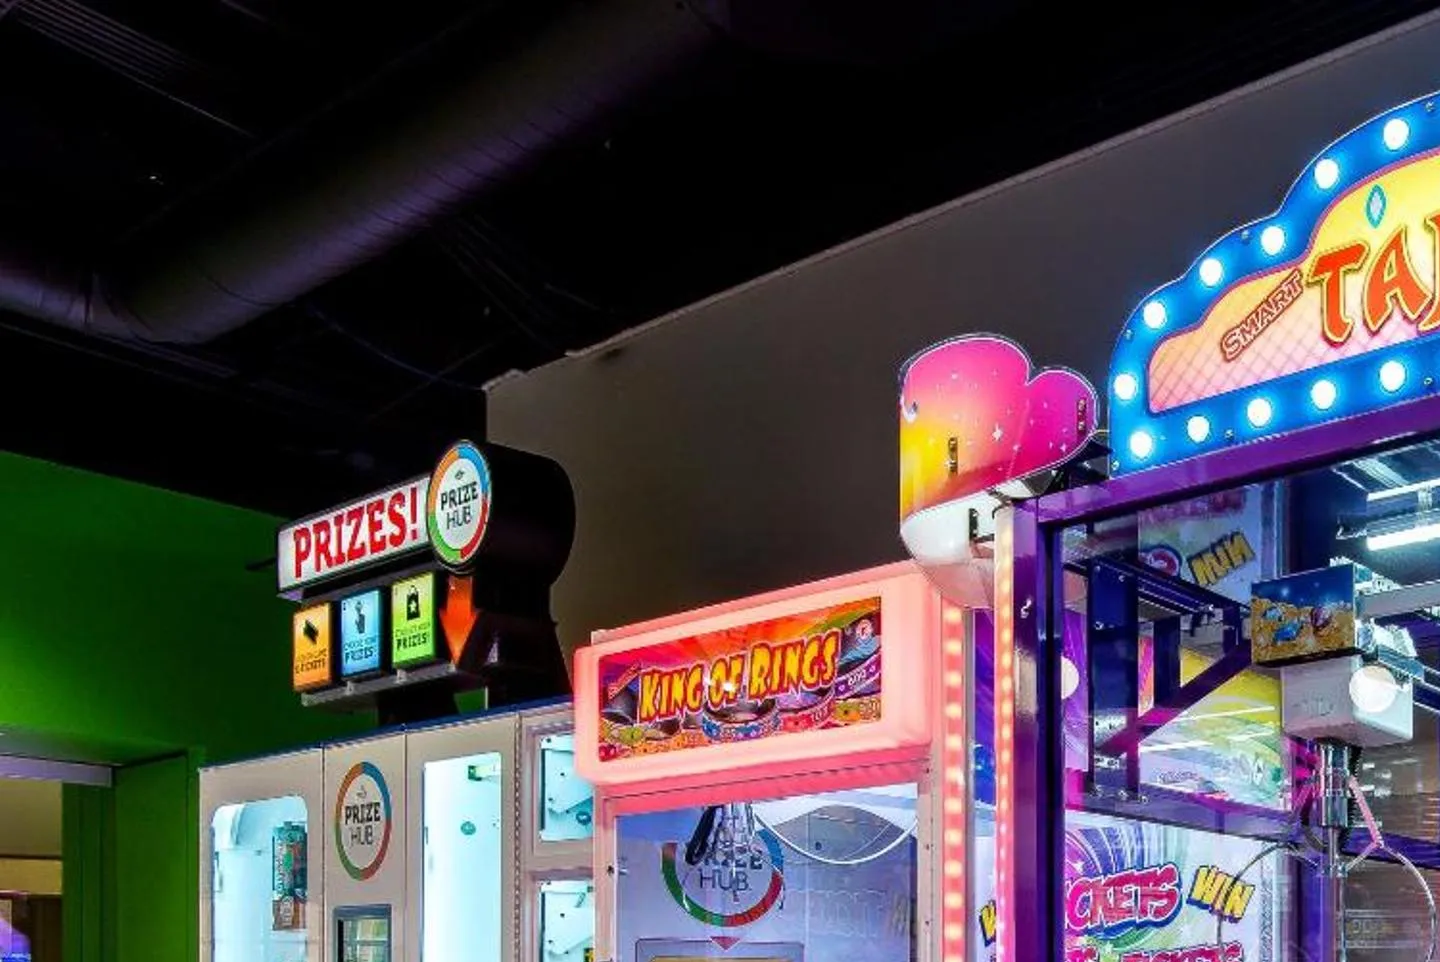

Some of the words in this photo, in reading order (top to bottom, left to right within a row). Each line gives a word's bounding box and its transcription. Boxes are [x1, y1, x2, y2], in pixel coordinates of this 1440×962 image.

[1221, 272, 1304, 361] SMART
[440, 481, 478, 511] PRIZE
[293, 487, 418, 578] PRIZES!
[447, 509, 473, 530] HUB
[639, 664, 704, 723] KING
[707, 654, 745, 708] OF
[749, 629, 841, 698] RINGS
[345, 803, 380, 825] PRIZE
[350, 826, 374, 845] HUB
[700, 869, 749, 891] HUB
[1066, 864, 1179, 930] CKETS
[1188, 865, 1254, 922] WIN
